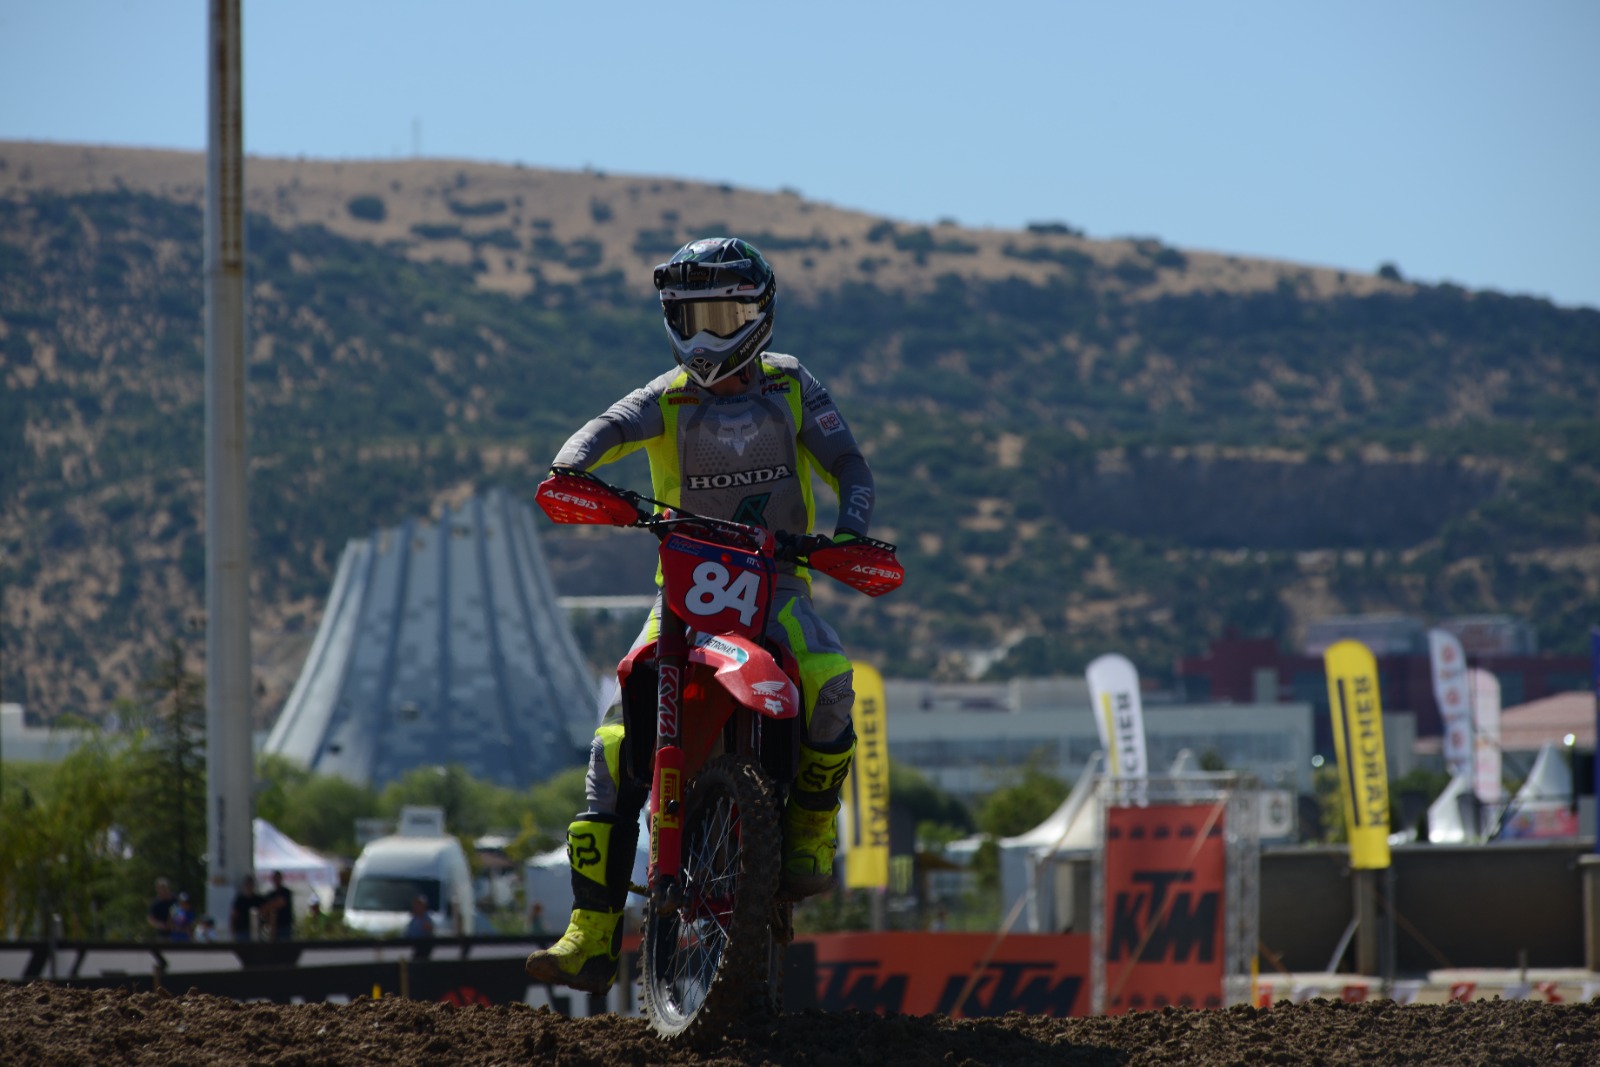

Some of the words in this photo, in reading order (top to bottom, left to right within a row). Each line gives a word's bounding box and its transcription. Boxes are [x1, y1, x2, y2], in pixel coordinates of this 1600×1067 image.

[542, 489, 599, 510] ACERBIS
[688, 464, 792, 490] HONDA
[847, 484, 872, 524] FOX
[684, 561, 761, 628] 84
[851, 564, 902, 580] ACERBIS
[704, 636, 737, 655] PETRONAS
[658, 665, 679, 738] KYB
[1107, 871, 1219, 963] KTM
[815, 960, 906, 1014] TM
[934, 960, 1083, 1017] KTM
